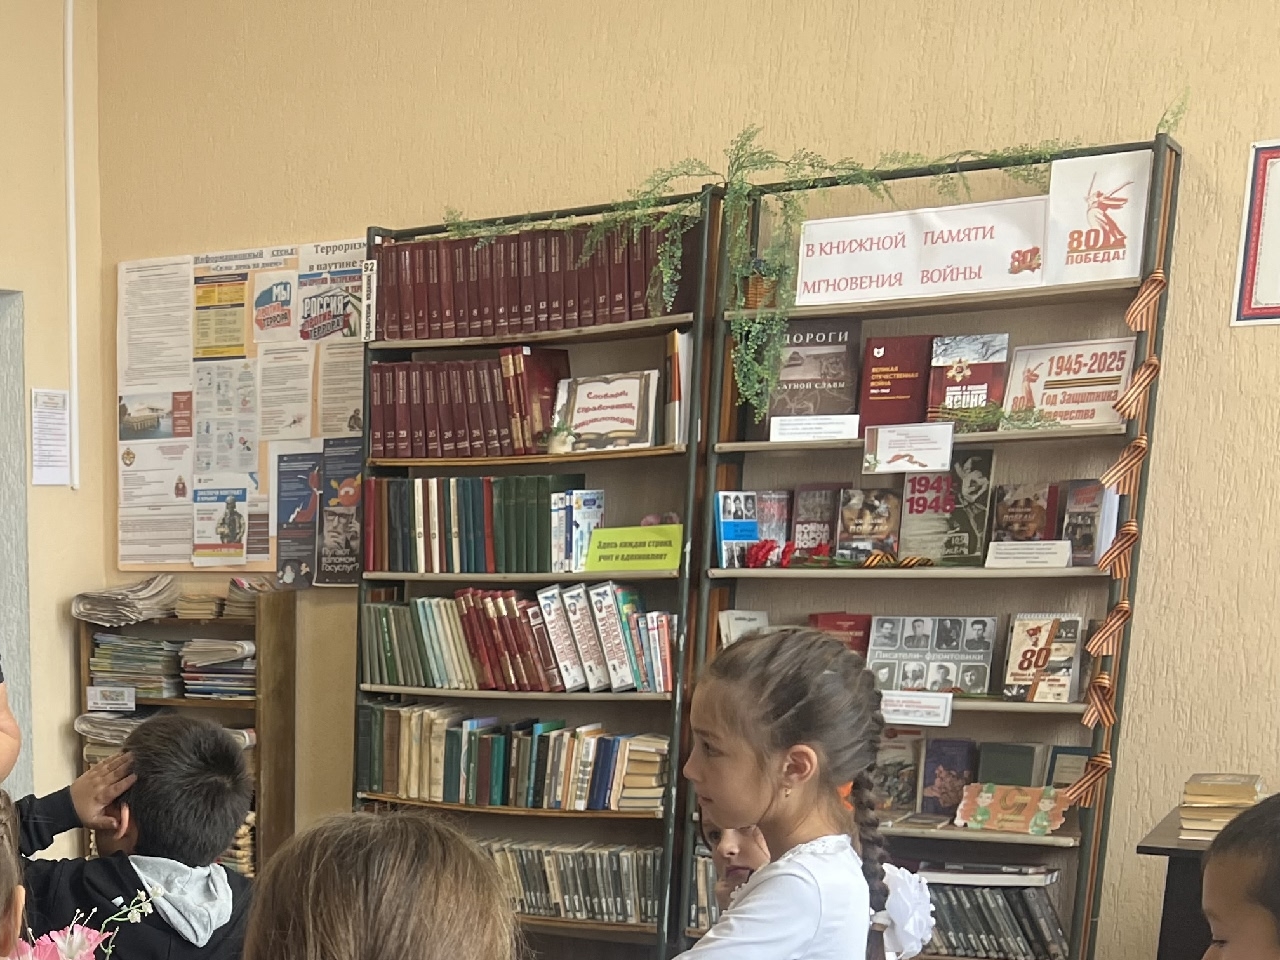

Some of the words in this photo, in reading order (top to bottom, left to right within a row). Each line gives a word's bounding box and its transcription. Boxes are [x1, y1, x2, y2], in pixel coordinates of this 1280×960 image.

[806, 243, 815, 257] В
[819, 231, 906, 256] КНИЖНОЙ
[923, 225, 995, 245] ПАМЯТИ
[1067, 228, 1101, 251] 80
[1065, 250, 1126, 265] ПОБЕДА!
[316, 260, 356, 272] паутине
[363, 261, 374, 273] 92
[802, 272, 903, 294] МГНОВЕНИЯ
[920, 265, 983, 285] ВОЙНЫ
[272, 283, 291, 301] МЫ
[303, 295, 346, 319] РОССИЯ
[1048, 350, 1126, 376] 1945-2025
[778, 382, 812, 390] АТНОЙ
[815, 381, 845, 389] СЛАВЫ
[1041, 393, 1057, 405] Год
[1061, 389, 1119, 405] Защитника
[906, 497, 955, 514] 1945
[597, 540, 617, 549] Здесь
[619, 540, 646, 549] каждая
[598, 554, 613, 562] учит
[925, 652, 984, 661] фронтовики
[1018, 647, 1051, 671] 80
